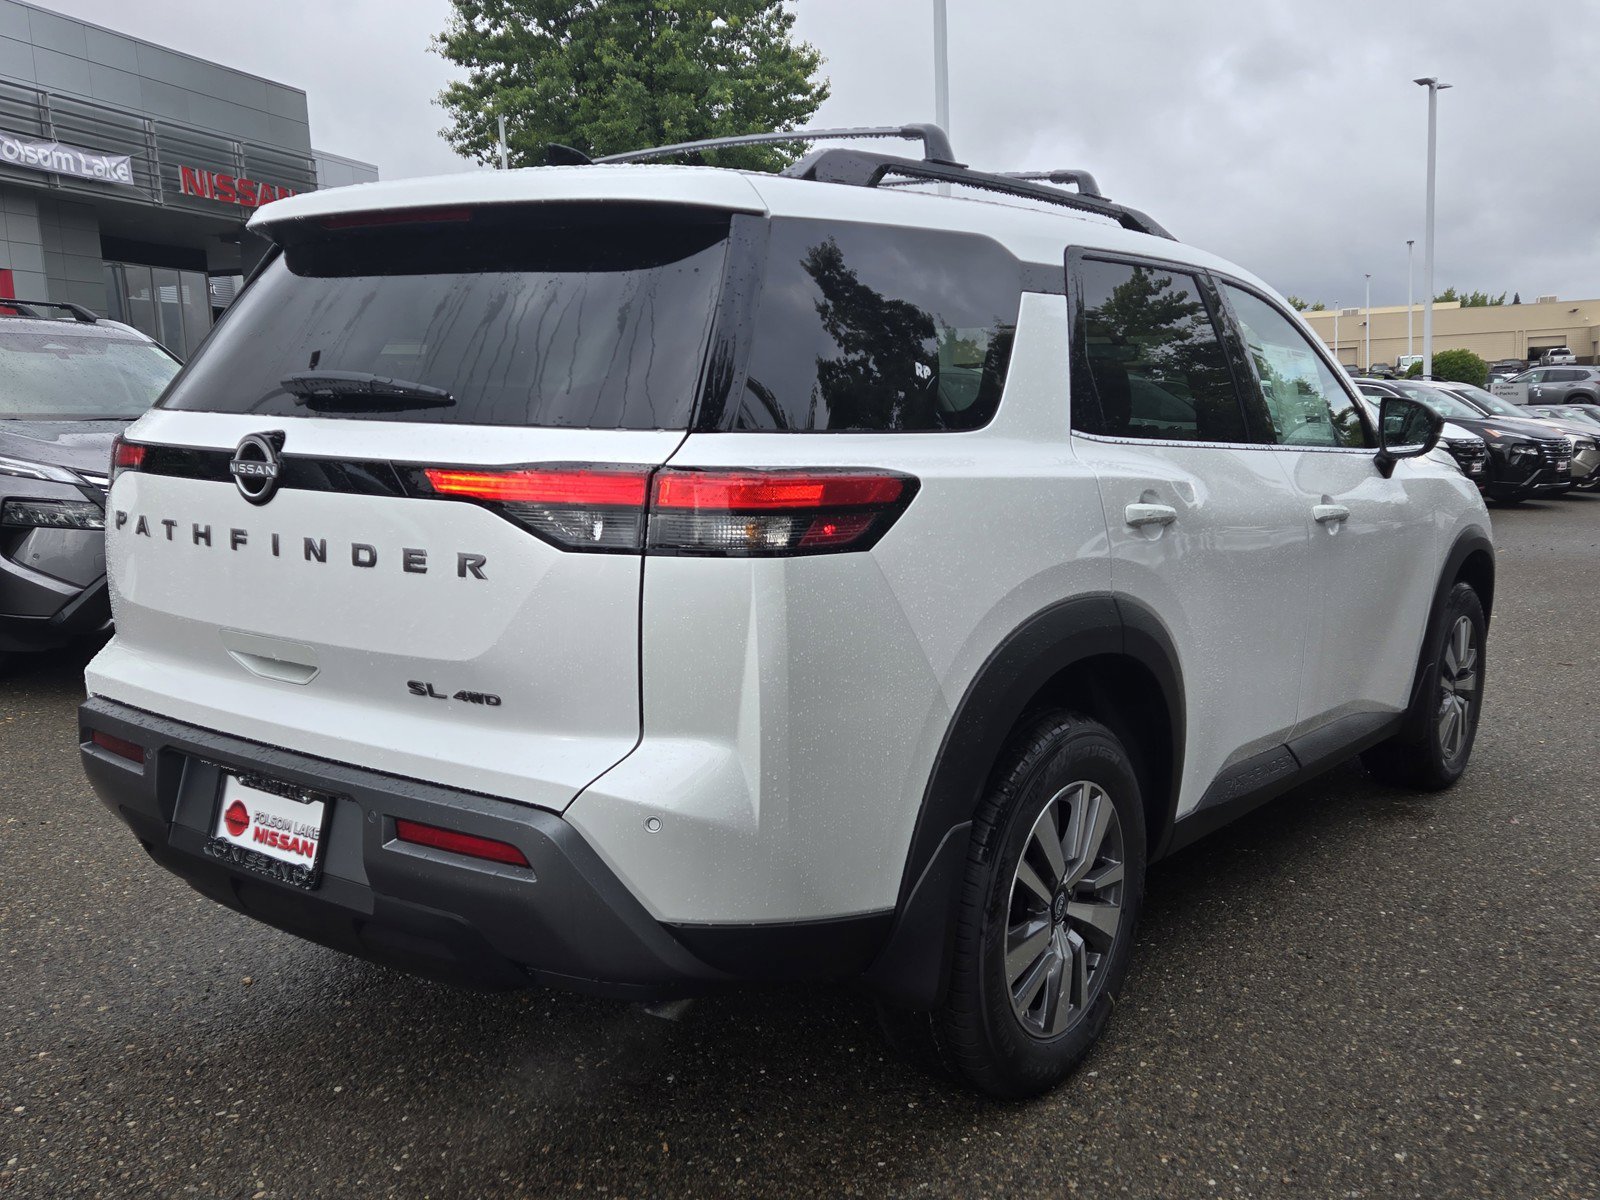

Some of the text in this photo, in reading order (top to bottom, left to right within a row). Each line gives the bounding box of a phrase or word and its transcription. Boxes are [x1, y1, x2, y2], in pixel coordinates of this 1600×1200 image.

[0, 138, 130, 180] olsom Lake
[230, 462, 276, 476] NISSAN
[115, 509, 488, 580] PATHFINDER
[407, 680, 501, 706] SL 4WD
[253, 811, 320, 840] FOLSOM LAKE
[253, 826, 315, 858] NISSAN
